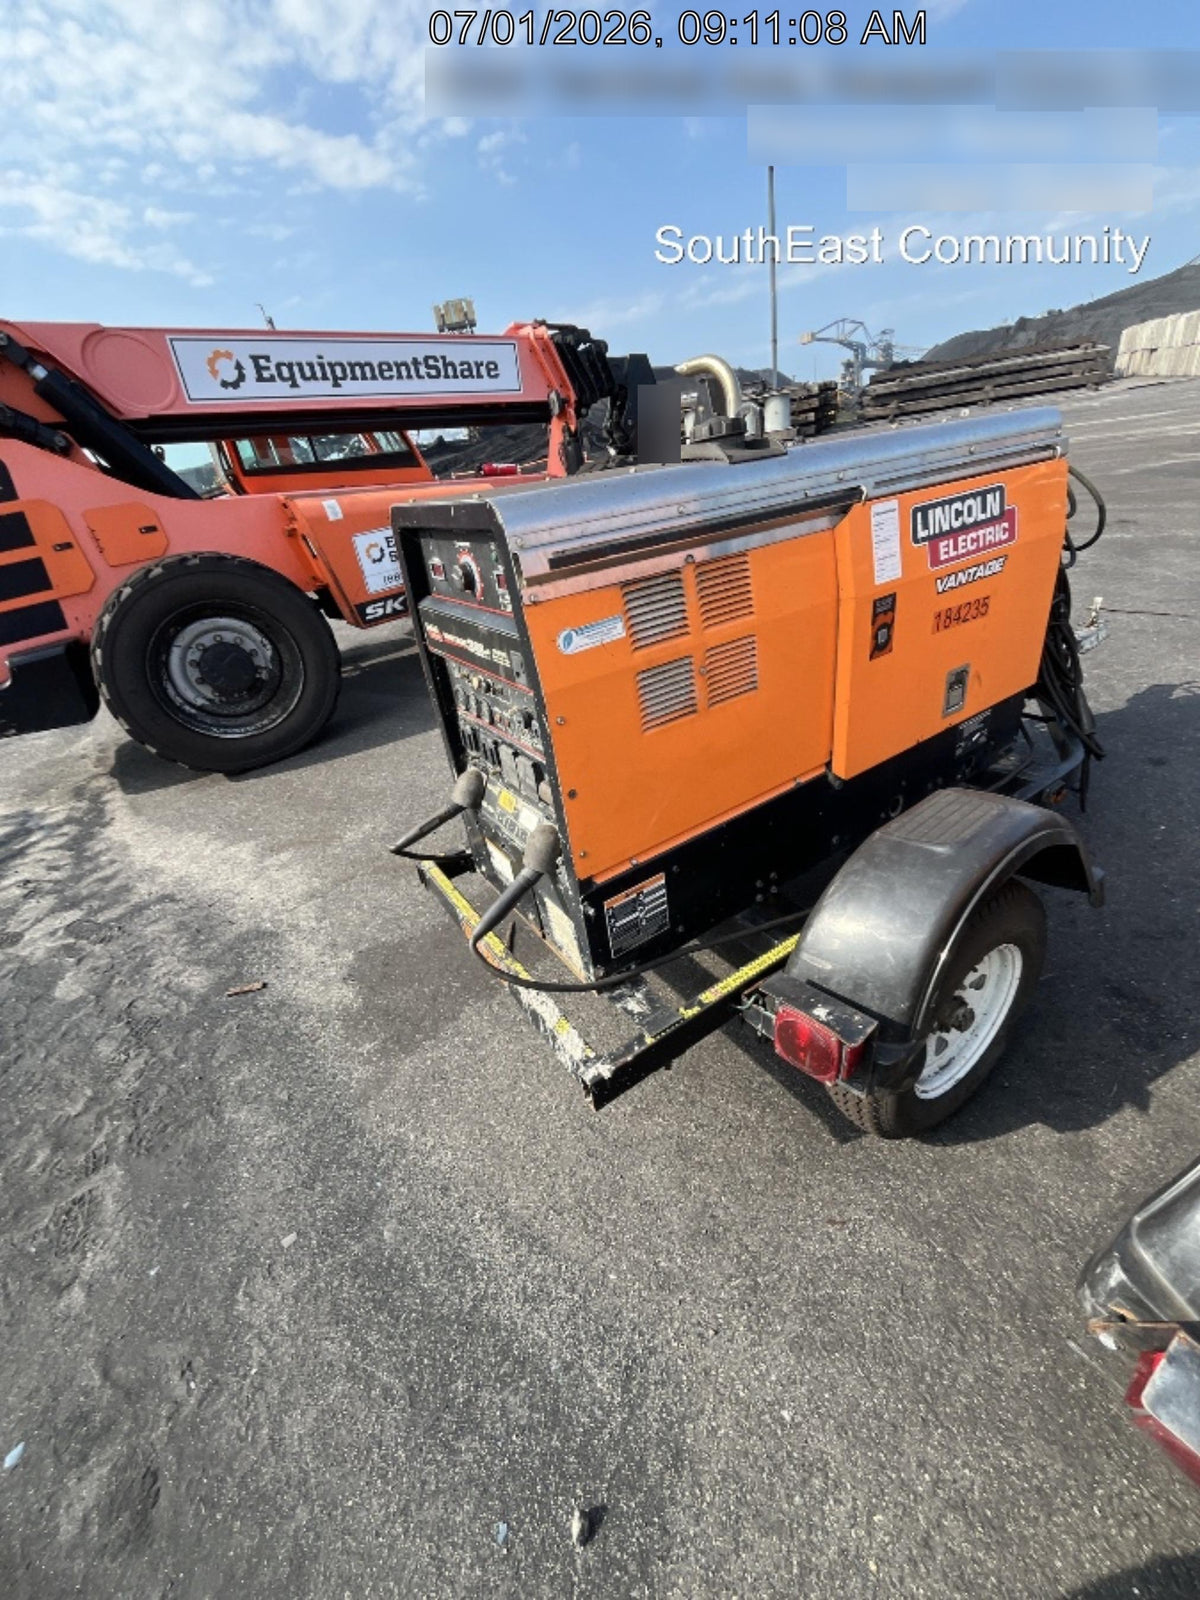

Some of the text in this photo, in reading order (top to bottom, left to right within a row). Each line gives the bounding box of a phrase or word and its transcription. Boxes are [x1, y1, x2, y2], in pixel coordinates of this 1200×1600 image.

[249, 354, 500, 388] EquipmentShare
[916, 489, 1000, 539] LINCOLN
[938, 521, 1009, 561] ELECTRIC
[935, 555, 1007, 594] VANTAGE
[933, 595, 991, 633] 184235
